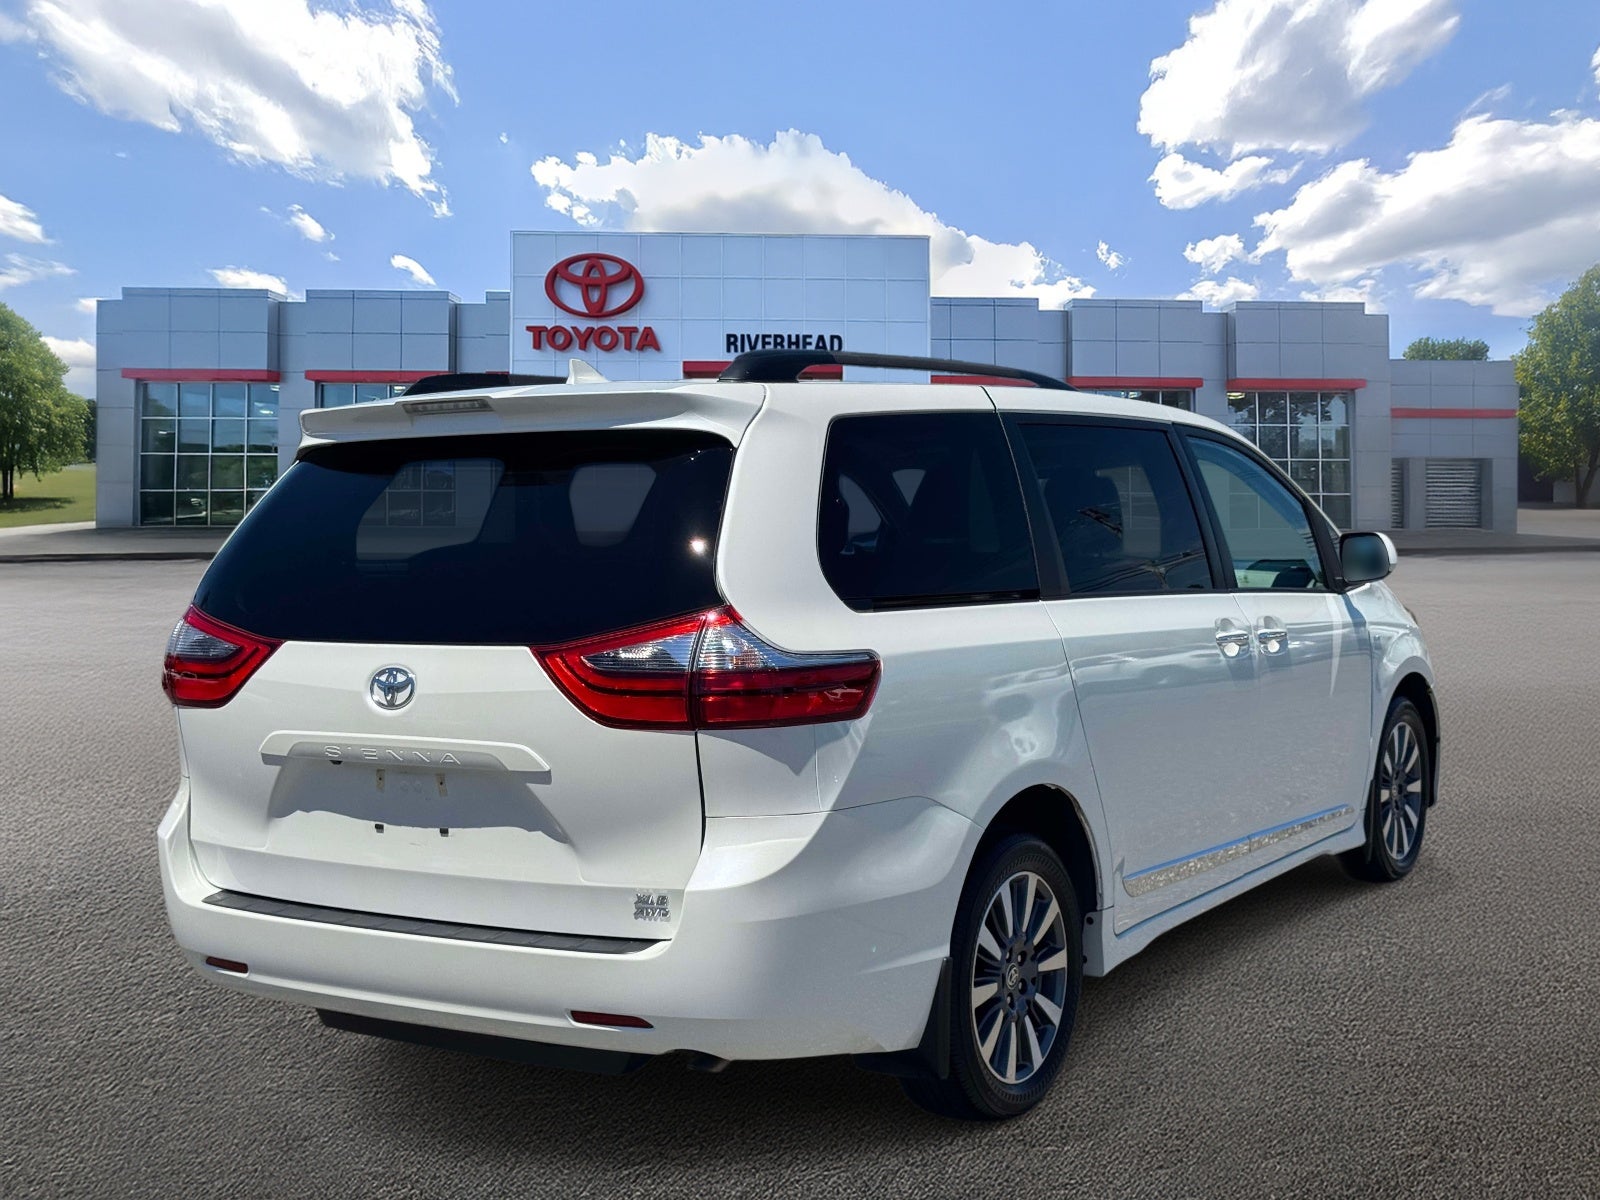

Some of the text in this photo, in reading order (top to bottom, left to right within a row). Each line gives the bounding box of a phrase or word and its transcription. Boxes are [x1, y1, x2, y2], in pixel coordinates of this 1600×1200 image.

[525, 325, 661, 351] TOYOTA
[726, 333, 843, 353] RIVERHEAD
[323, 745, 461, 765] SIENNA
